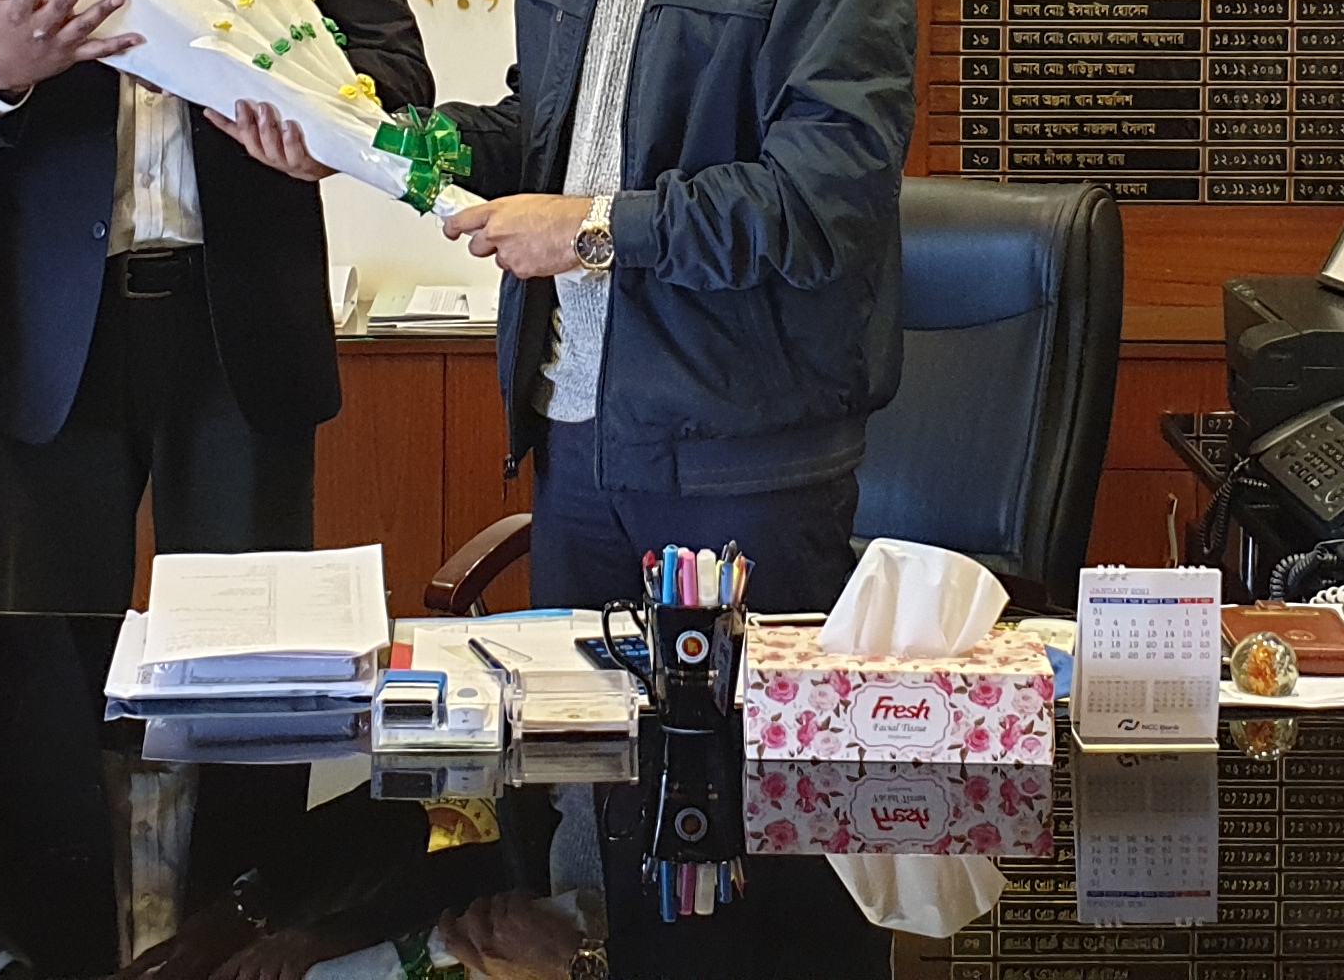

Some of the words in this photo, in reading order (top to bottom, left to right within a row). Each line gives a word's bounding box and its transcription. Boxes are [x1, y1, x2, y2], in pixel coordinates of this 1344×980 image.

[973, 3, 990, 15] ১৫
[972, 33, 990, 46] ১৬
[973, 63, 989, 76] ১৭
[971, 93, 989, 106] ১৮
[972, 123, 989, 135] ১৯
[972, 153, 990, 166] ২০
[1013, 153, 1041, 166] জনাব
[871, 696, 930, 720] Fresh
[873, 722, 900, 732] Facial
[902, 723, 928, 733] Tissue
